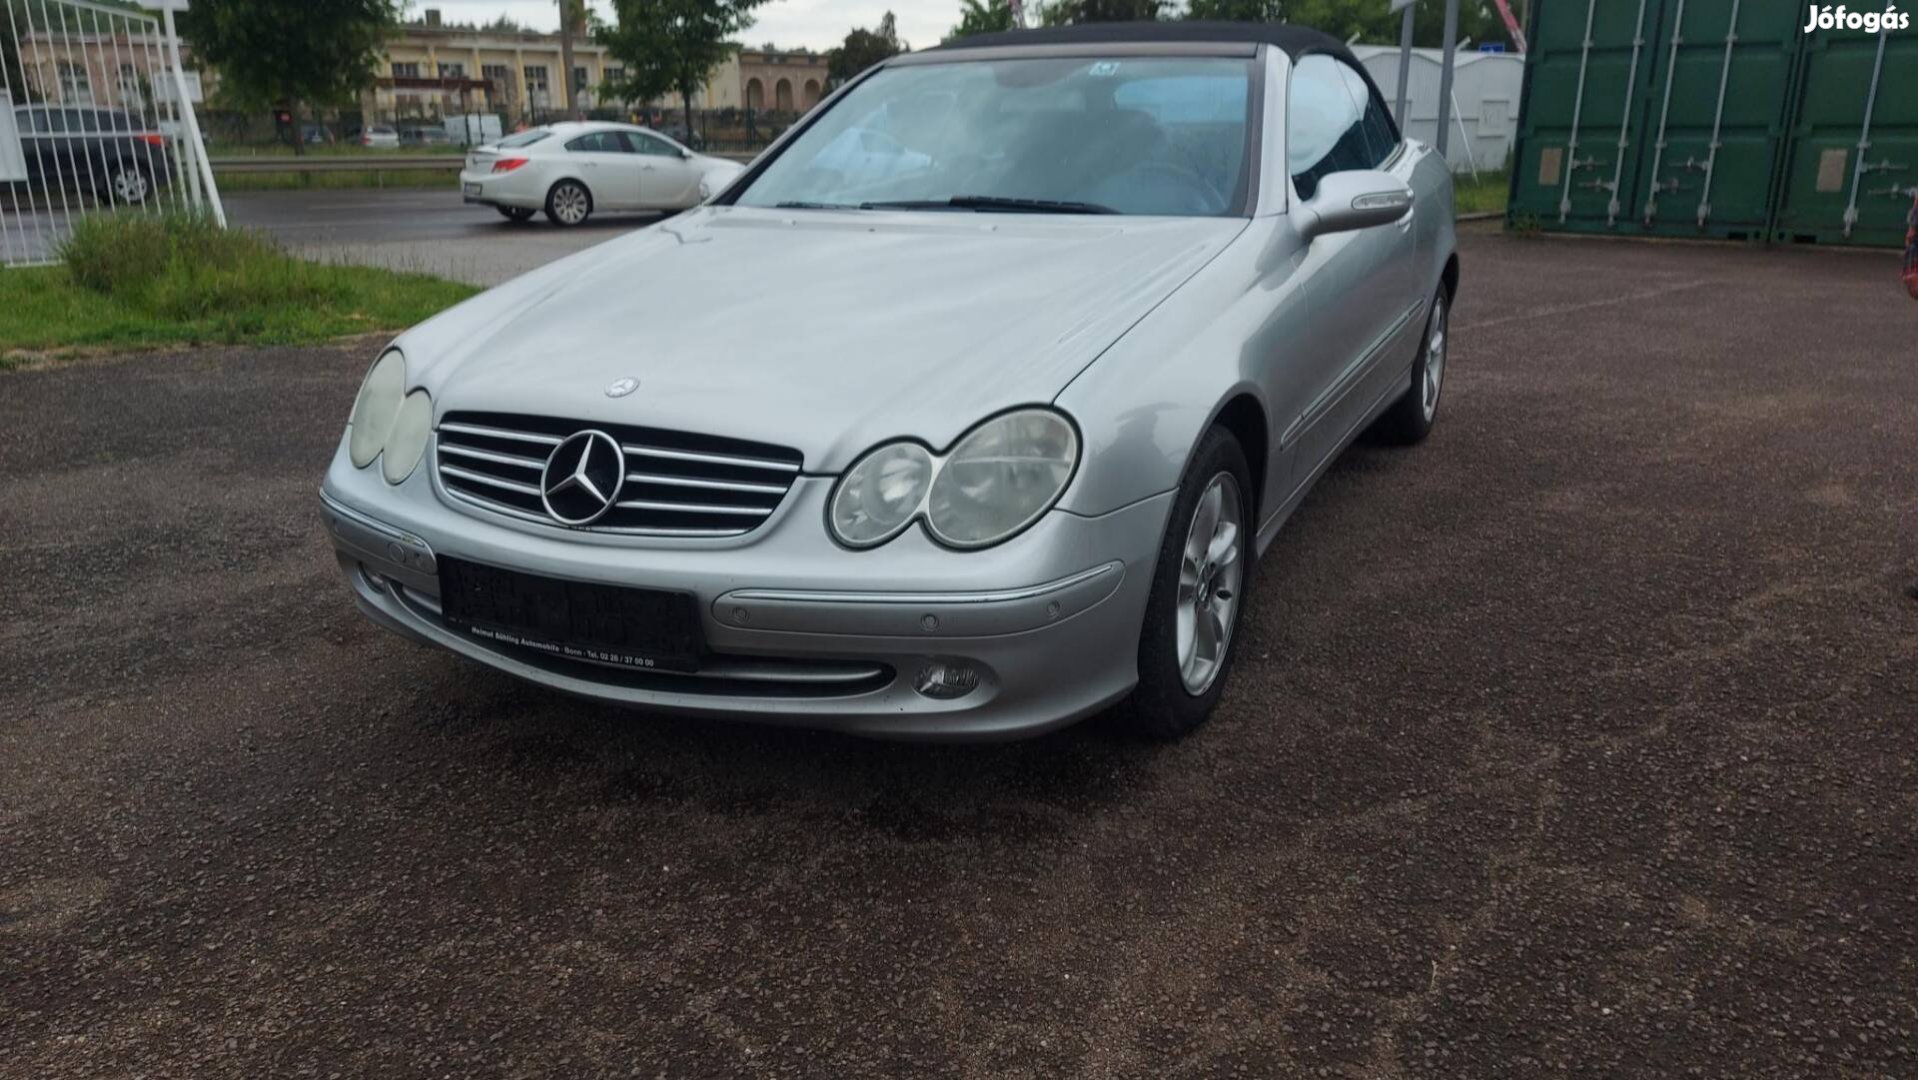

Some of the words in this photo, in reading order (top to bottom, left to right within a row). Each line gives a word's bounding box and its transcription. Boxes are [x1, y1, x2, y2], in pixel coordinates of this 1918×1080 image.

[520, 637, 560, 652] Automobile
[564, 646, 582, 656] Bonn
[600, 652, 608, 660] 02
